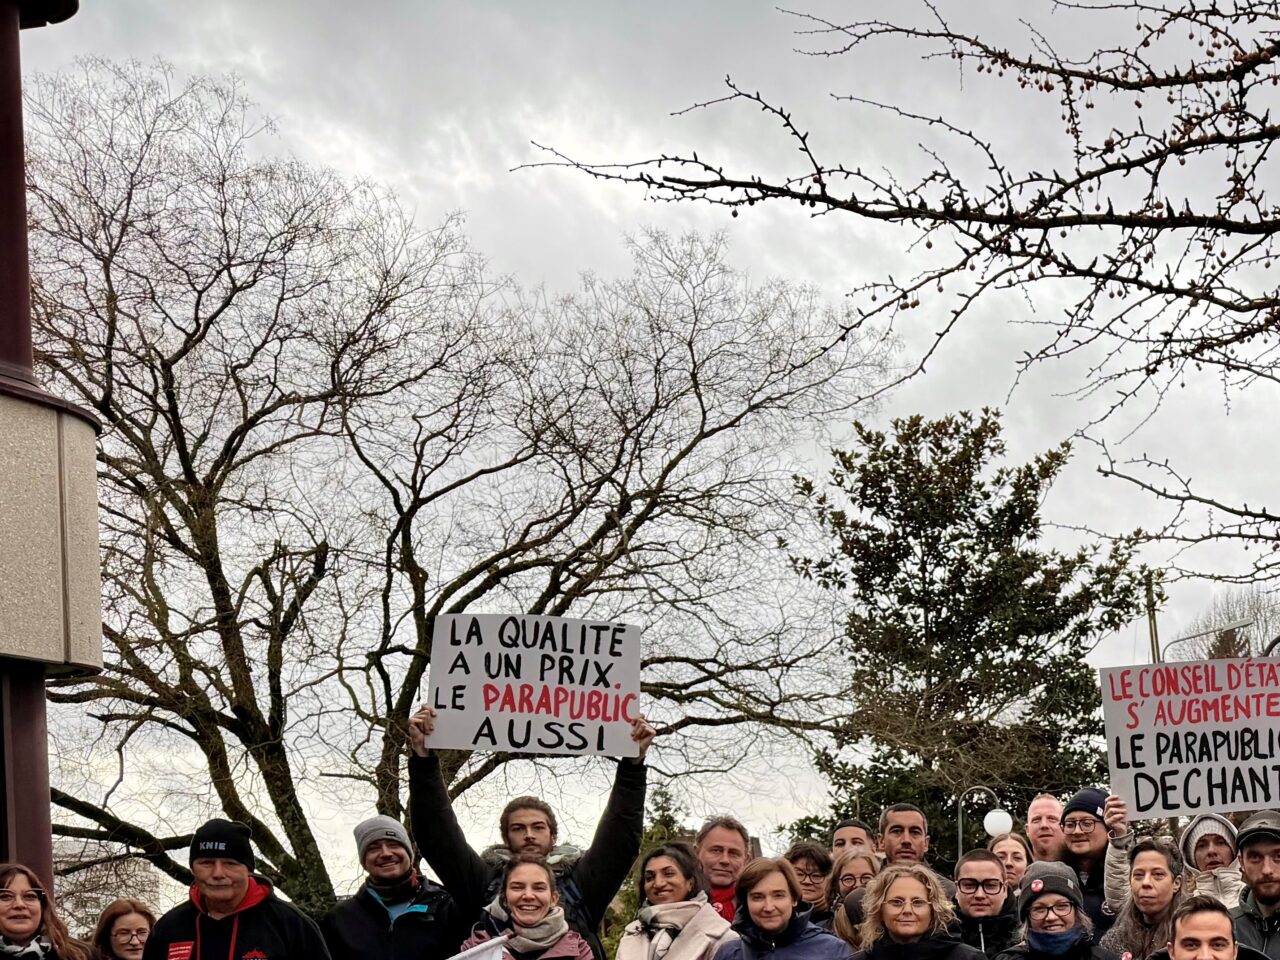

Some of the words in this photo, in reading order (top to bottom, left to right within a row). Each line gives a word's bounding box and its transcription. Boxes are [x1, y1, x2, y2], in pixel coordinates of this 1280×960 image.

[449, 616, 483, 646] LA
[498, 616, 626, 657] QUALITÉ
[448, 651, 471, 675] A
[484, 652, 522, 679] UN
[539, 654, 614, 688] PRIX
[1109, 669, 1134, 701] LE
[1138, 664, 1223, 698] CONSEIL
[434, 685, 467, 710] LE
[472, 717, 605, 751] AUSSI
[1115, 733, 1146, 769] LE
[199, 841, 226, 850] KNIE
